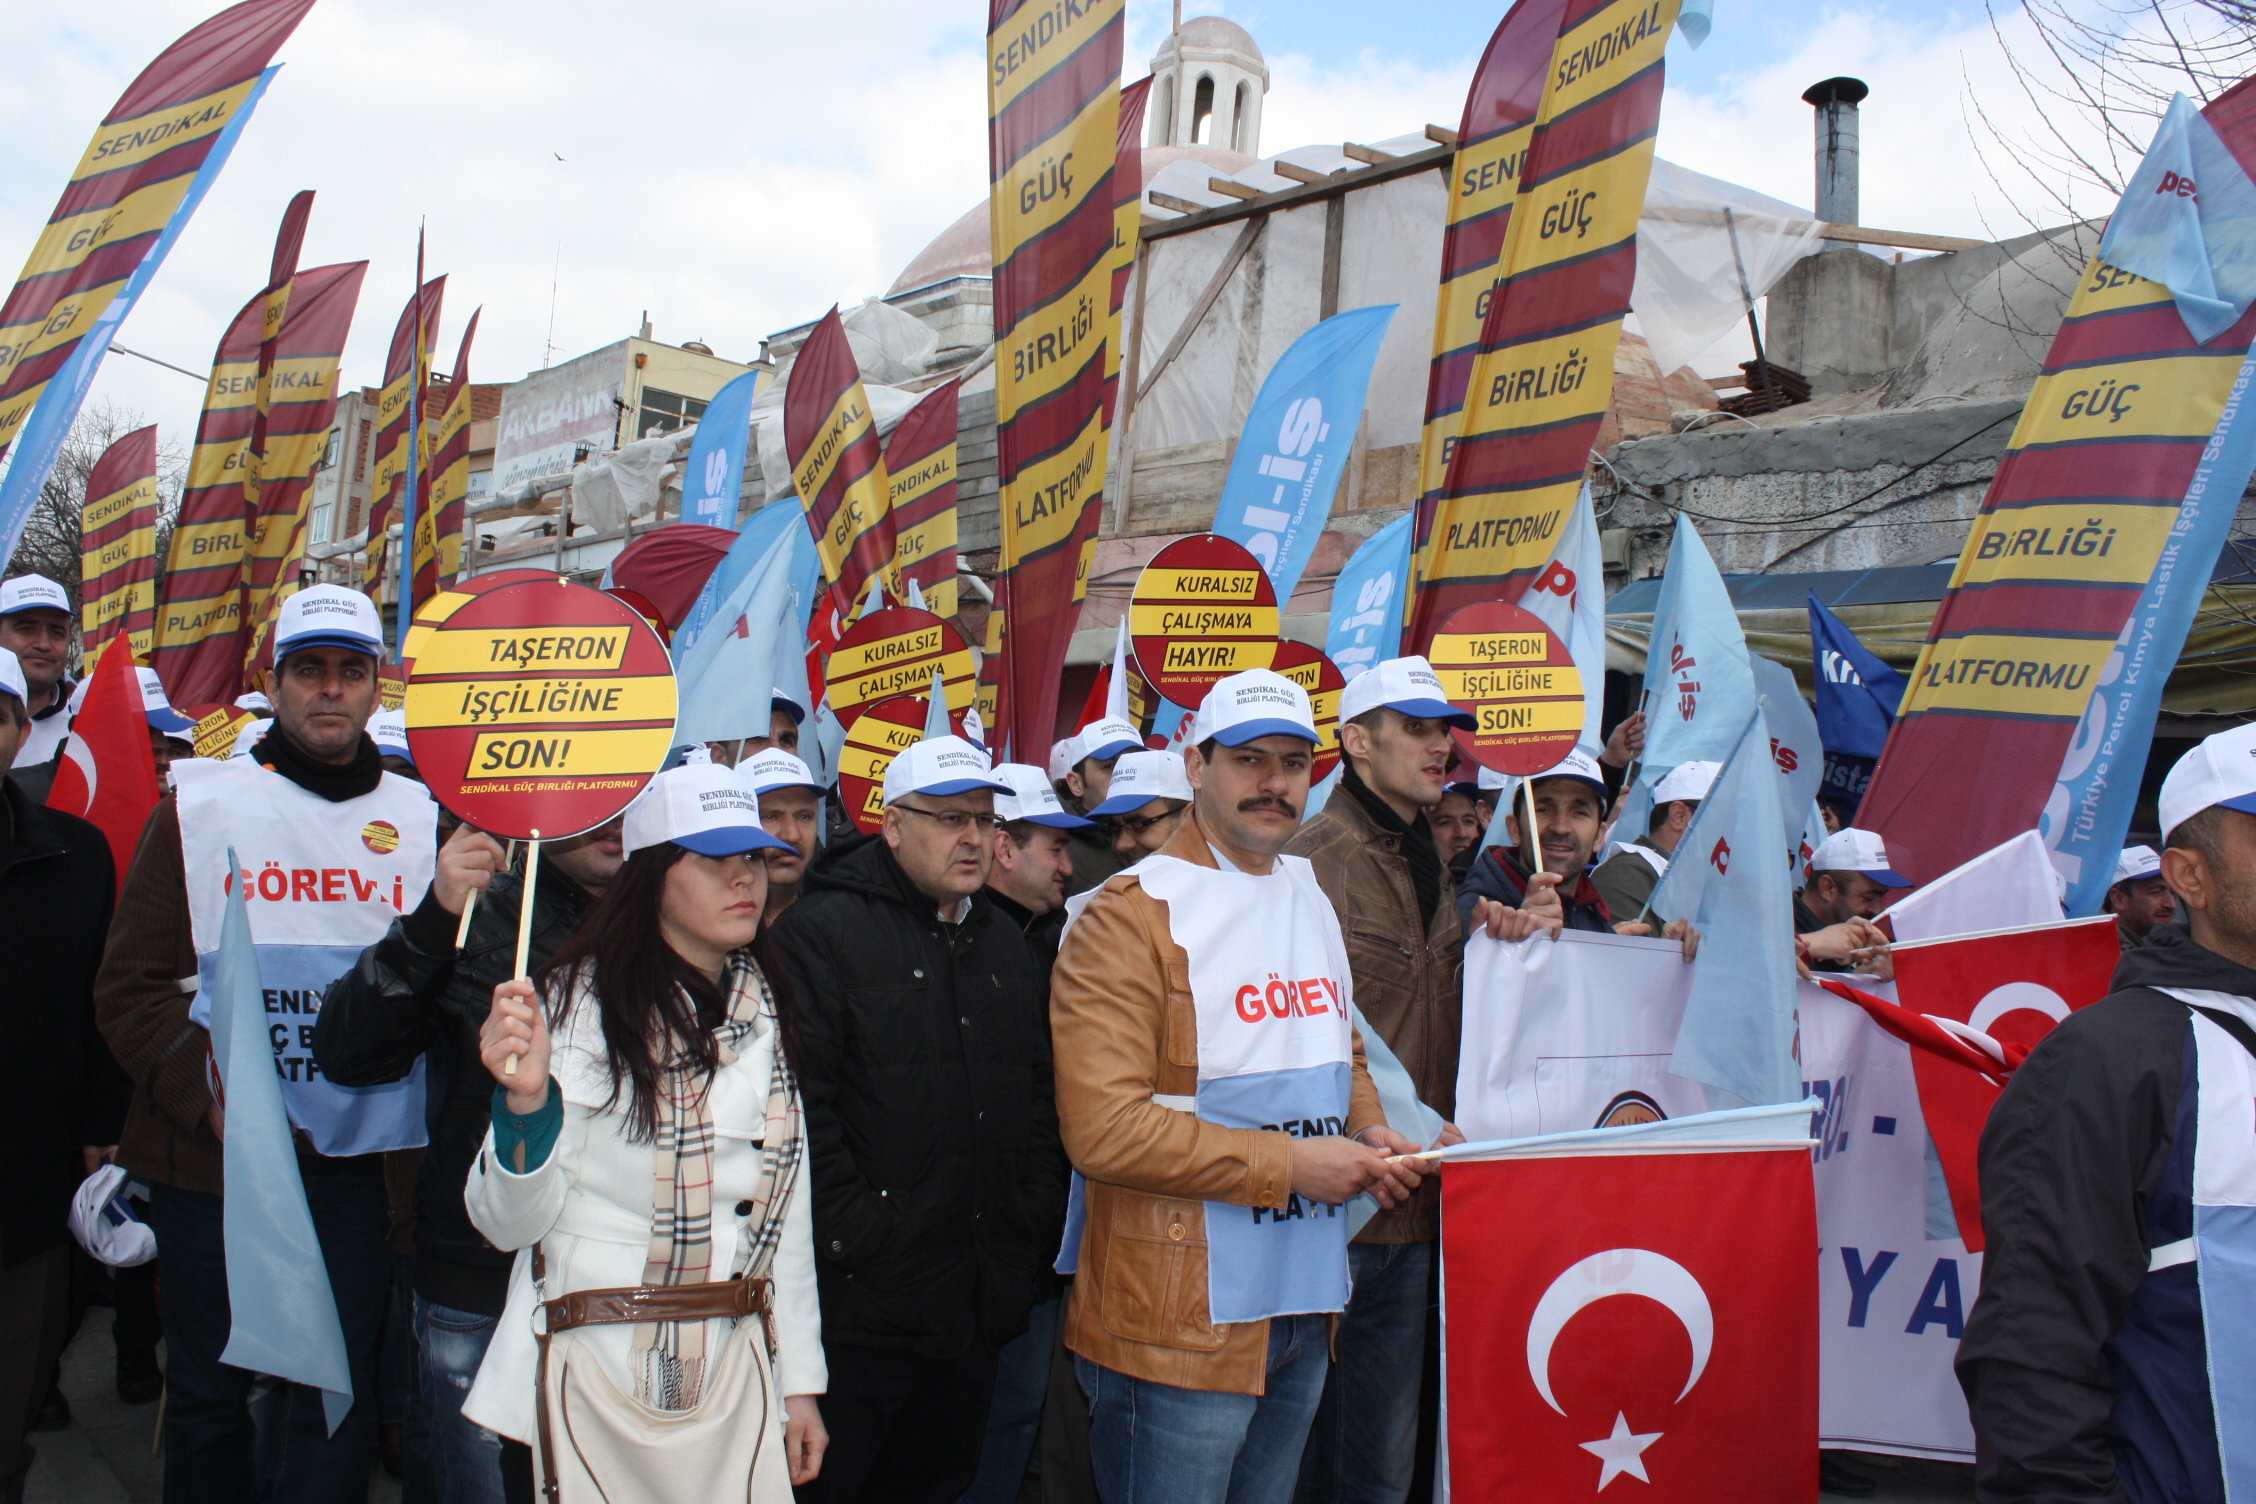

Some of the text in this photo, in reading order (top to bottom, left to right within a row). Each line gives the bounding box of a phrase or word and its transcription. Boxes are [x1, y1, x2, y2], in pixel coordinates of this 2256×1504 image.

[1020, 152, 1074, 215] GÜÇ
[1540, 189, 1597, 239] GÜÇ
[215, 371, 324, 395] SENiKAL
[2061, 378, 2140, 423] GÜÇ
[835, 500, 863, 546] GÜÇ
[1445, 510, 1561, 552] PLATFORMU
[102, 543, 129, 565] GÜÇ
[1175, 576, 1255, 593] KURALSIZ
[302, 596, 341, 609] SENDİKAL
[342, 600, 358, 610] GÜÇ
[302, 605, 358, 616] BİRLİĞİ PLATFORMU
[1162, 612, 1253, 634] ÇALIŞMAYA
[490, 635, 617, 669] TAŞERON
[864, 631, 938, 664] KURALSIZ
[1168, 647, 1236, 667] HAYIR!
[1469, 639, 1541, 662] TAŞERON
[859, 661, 945, 699] ÇALIŞMAYA
[1462, 669, 1553, 698] İŞÇİLİĞİNE
[460, 681, 623, 723] İŞÇİLİĞİNE
[1236, 684, 1296, 701] SENDİKAL GÜÇ
[1236, 693, 1260, 706] BİRLİĞİ
[2072, 762, 2109, 843] Türkiye
[2102, 692, 2133, 757] Petrol
[2125, 617, 2157, 686] Kimya
[2148, 543, 2182, 610] Lastik
[1482, 707, 1533, 730] SON!
[1504, 736, 1517, 745] GÜÇ
[1540, 734, 1575, 742] PLATFORMU
[481, 739, 572, 770] SON!
[753, 758, 787, 770] SENDİKAL
[513, 781, 535, 793] GÜÇ
[576, 779, 638, 790] PLATFORMU
[699, 787, 742, 802] SENDİKAL
[701, 799, 729, 813] BİRLİĞİ
